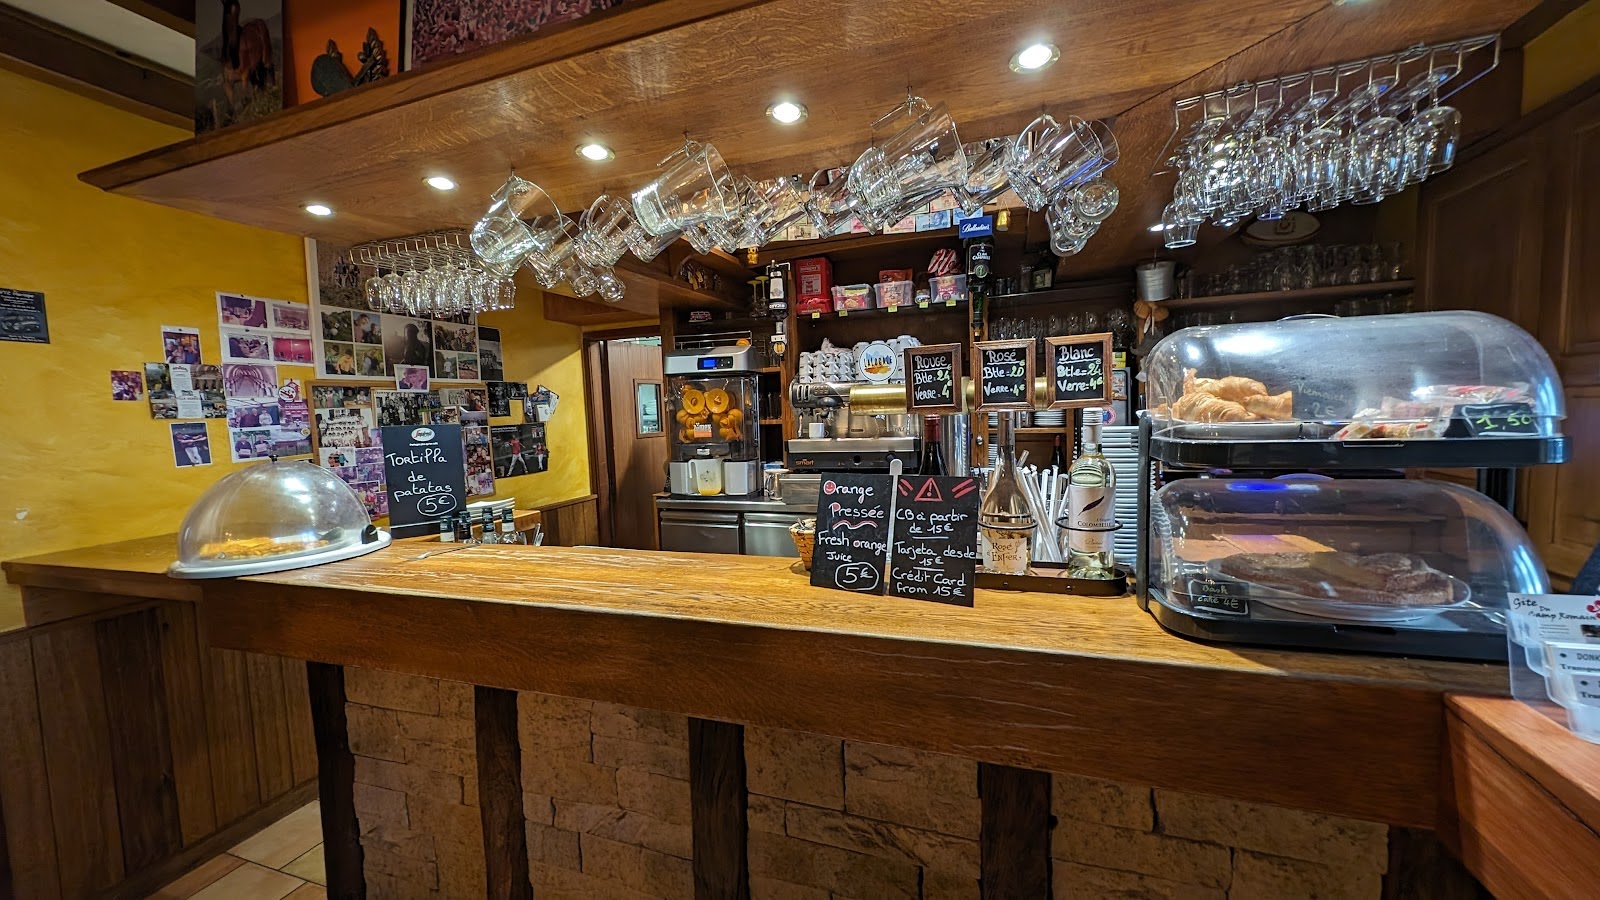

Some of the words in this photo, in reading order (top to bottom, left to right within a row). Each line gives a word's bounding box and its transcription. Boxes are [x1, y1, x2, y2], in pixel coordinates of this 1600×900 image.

[1058, 346, 1094, 361] Blanc
[407, 471, 426, 482] de
[394, 482, 452, 503] patatas
[823, 480, 874, 504] Orange
[424, 496, 450, 513] 5€
[828, 502, 884, 519] Pressée
[896, 508, 915, 521] CB
[917, 510, 926, 521] à
[930, 510, 968, 525] partir
[909, 522, 923, 534] de
[926, 522, 954, 534] 15€
[818, 530, 850, 546] Fresh
[853, 539, 888, 556] orange
[894, 541, 938, 560] Tarjeta
[943, 545, 976, 560] desde
[826, 552, 852, 562] Juice
[918, 556, 944, 566] 15€
[842, 567, 874, 584] 5€
[934, 572, 966, 587] Card
[896, 582, 928, 595] from
[932, 586, 965, 597] 15€
